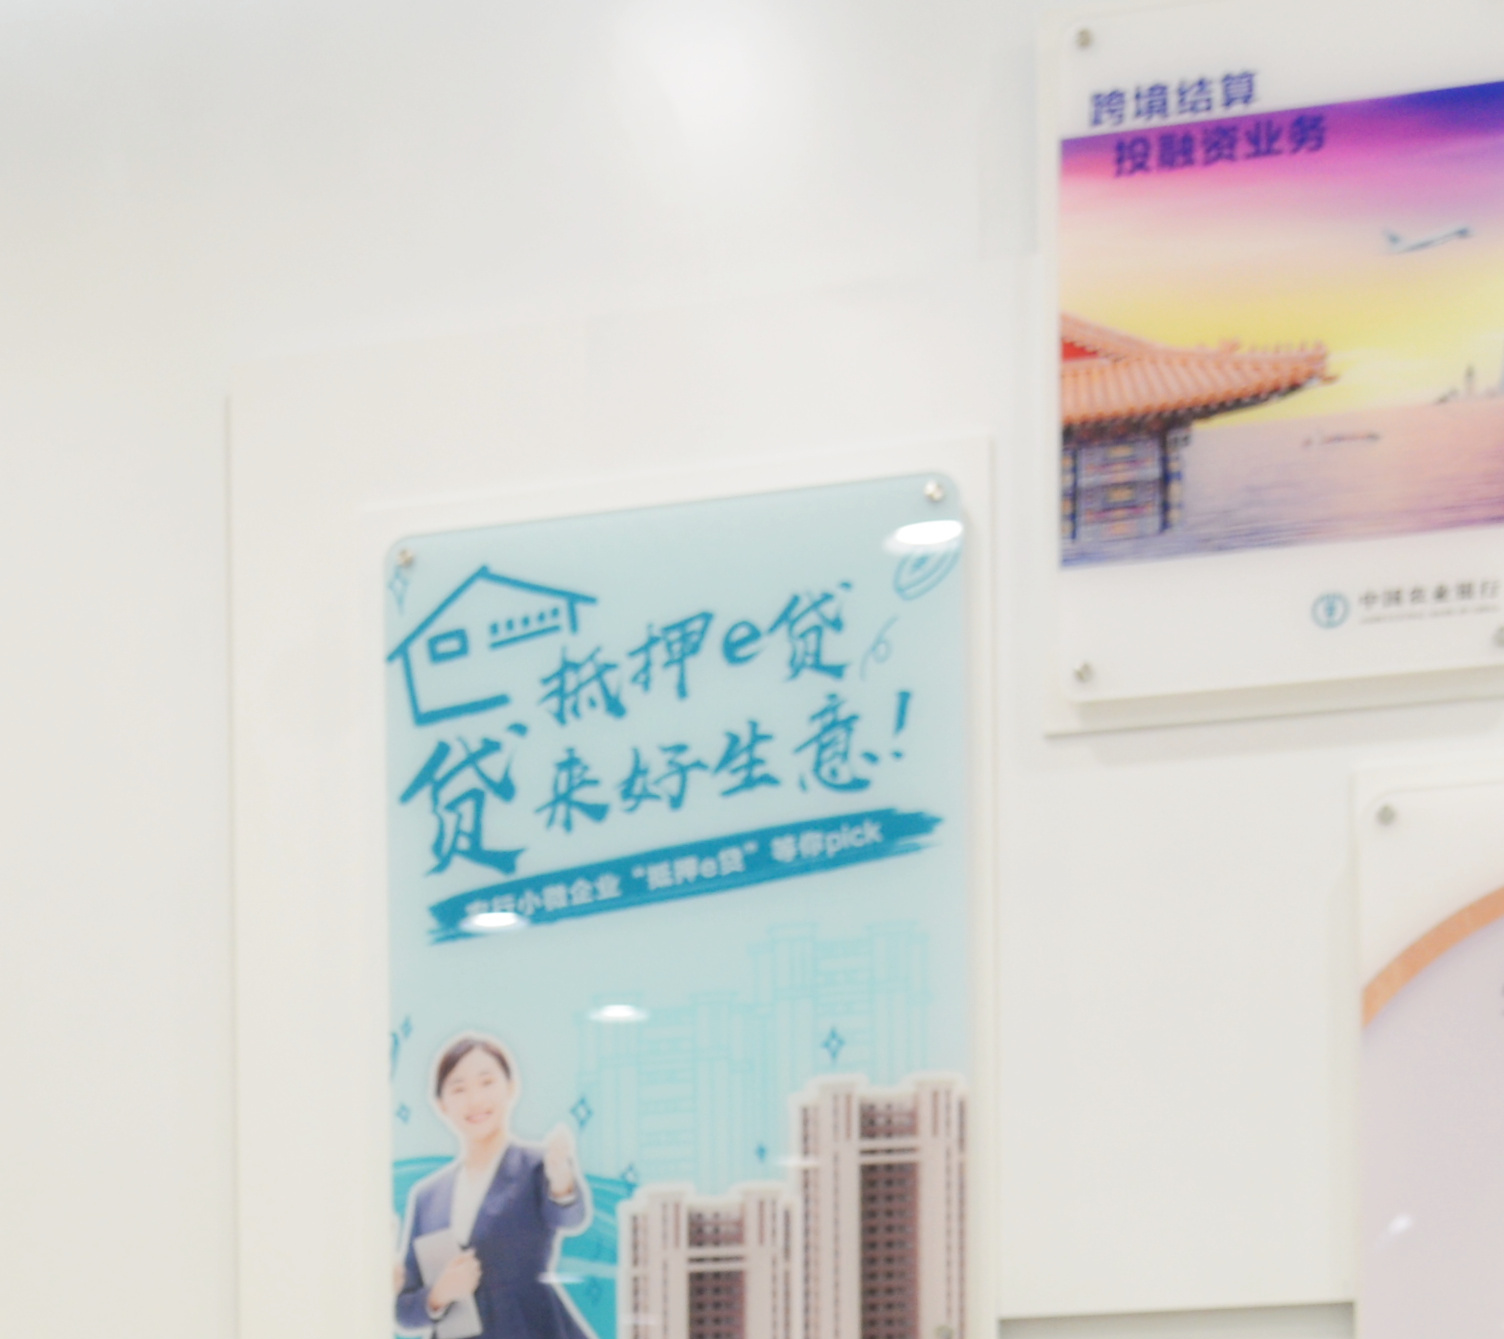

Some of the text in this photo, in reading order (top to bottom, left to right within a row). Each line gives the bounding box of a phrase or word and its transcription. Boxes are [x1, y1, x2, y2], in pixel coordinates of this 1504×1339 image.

[1090, 71, 1257, 127] 跨境结算
[1114, 115, 1326, 177] 投融资业务
[538, 580, 854, 726] 抵押e贷
